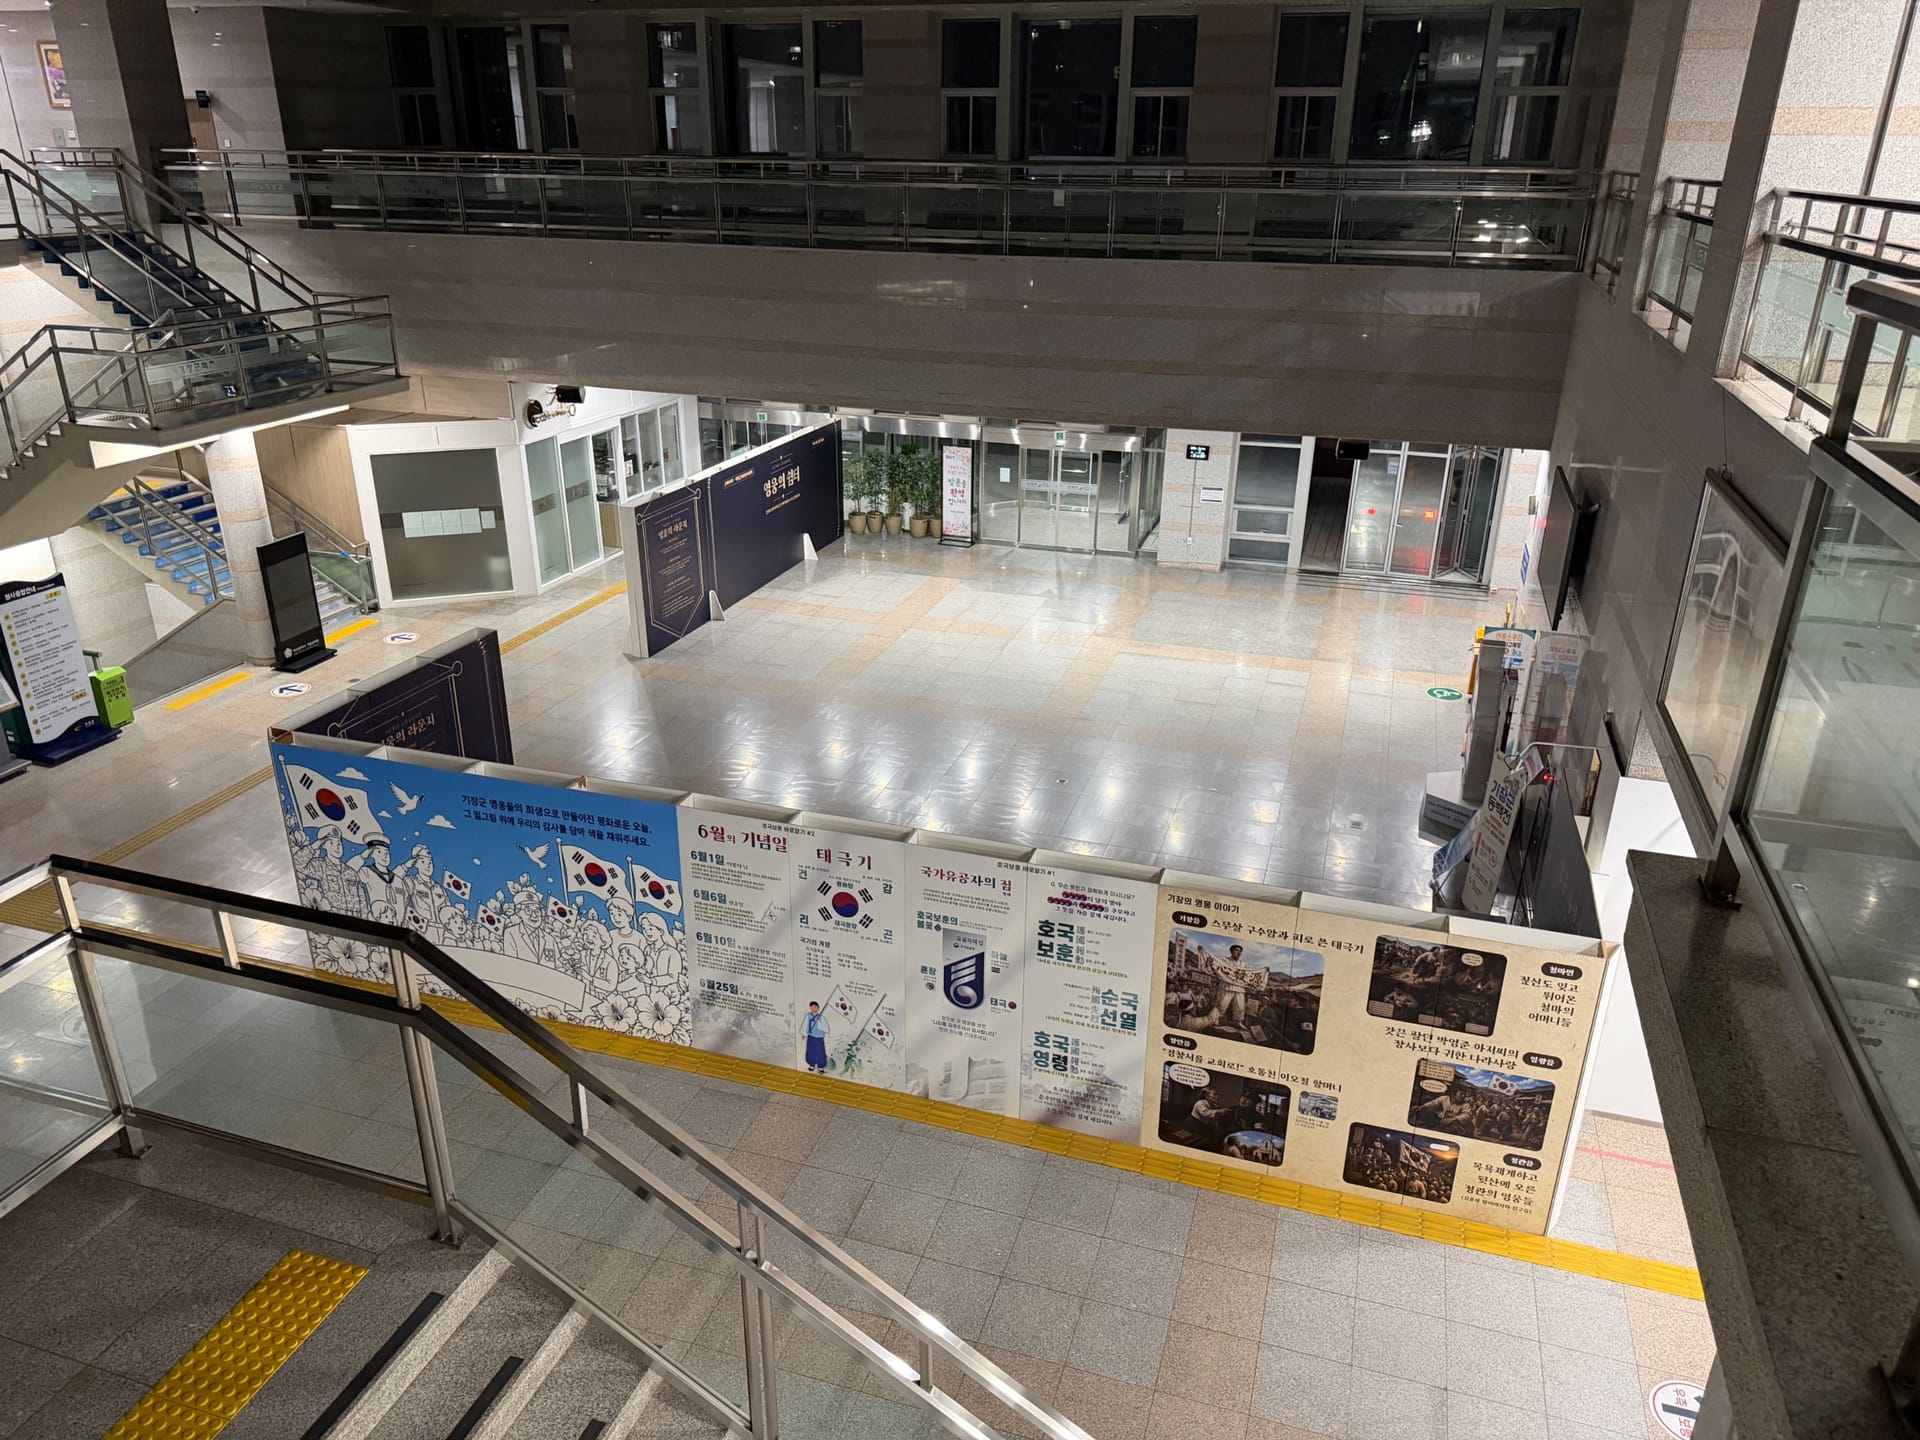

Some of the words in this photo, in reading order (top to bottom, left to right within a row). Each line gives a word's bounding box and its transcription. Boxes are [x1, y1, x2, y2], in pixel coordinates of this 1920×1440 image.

[763, 474, 786, 498] 영웅의
[786, 466, 800, 486] 쉼터
[378, 730, 406, 746] 웅의
[1491, 780, 1515, 813] 기장군
[462, 794, 487, 808] 기장군
[489, 798, 523, 813] 영웅들의
[526, 805, 560, 819] 희생으로
[562, 810, 595, 824] 만들어진
[597, 816, 631, 830] 평화로운
[1488, 796, 1512, 826] 동백전
[464, 809, 472, 818] 그
[499, 815, 515, 826] 위에
[517, 818, 540, 830] 우리의
[542, 821, 566, 834] 감사를
[569, 826, 585, 838] 담아
[588, 828, 604, 840] 색을
[698, 824, 736, 844] 6월의
[741, 832, 788, 853] 기념일
[920, 866, 996, 888] 국가유공자의
[1000, 880, 1012, 892] 집
[1167, 894, 1192, 906] 기장의
[1194, 898, 1212, 910] 영웅
[1214, 902, 1240, 914] 이야기
[917, 910, 958, 926] 호국보훈의
[1038, 920, 1075, 942] 호국
[1210, 920, 1244, 932] 스무살
[1246, 924, 1288, 941] 구수암과
[1292, 932, 1314, 945] 피로
[1331, 940, 1364, 954] 태극기
[1036, 940, 1074, 963] 보훈
[1550, 966, 1574, 976] 철마면
[1100, 988, 1138, 1011] 순국
[1540, 1002, 1574, 1016] 철마의
[1544, 992, 1576, 1006] 뛰어온
[1100, 1008, 1137, 1031] 선열
[1528, 1013, 1572, 1028] 어머니들
[1034, 1030, 1070, 1054] 호국
[1384, 1026, 1407, 1039] 갓끈
[1410, 1030, 1434, 1044] 팔던
[1474, 1042, 1519, 1059] 아저씨의
[1394, 1040, 1440, 1056] 장사보다
[1442, 1048, 1468, 1062] 귀한
[1470, 1054, 1518, 1070] 나라사랑
[1312, 1079, 1342, 1093] 할머니
[1465, 1184, 1497, 1199] 정관의
[1500, 1190, 1536, 1206] 영웅들
[1477, 1174, 1512, 1189] 뒷산에
[1514, 1181, 1537, 1194] 오른
